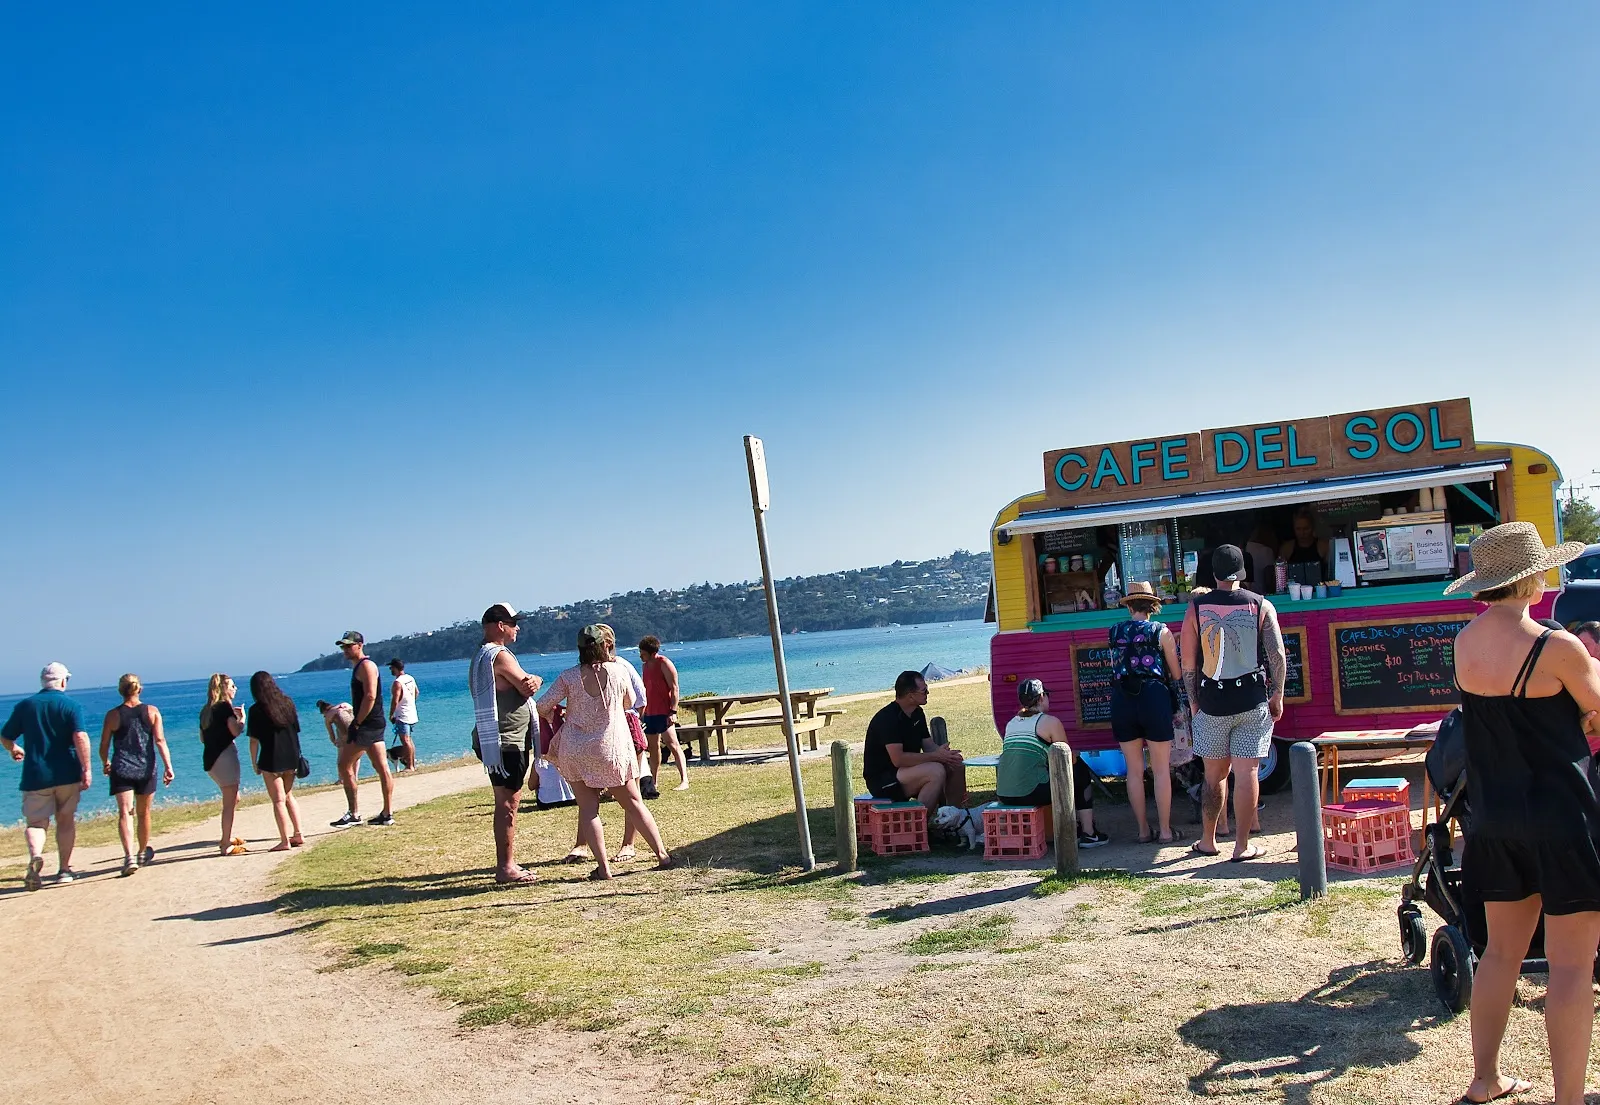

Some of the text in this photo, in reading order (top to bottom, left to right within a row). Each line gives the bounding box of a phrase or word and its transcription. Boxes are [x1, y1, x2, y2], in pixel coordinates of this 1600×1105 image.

[1053, 406, 1463, 492] CAFE DEL SOL
[1416, 540, 1444, 549] Business
[1340, 630, 1368, 644] CAFE
[1369, 628, 1390, 639] DEL
[1392, 627, 1409, 639] SOL
[1414, 624, 1434, 638] COLD
[1409, 638, 1428, 649] ICED
[1384, 654, 1402, 669] $10
[1397, 670, 1440, 684] ICY POLES
